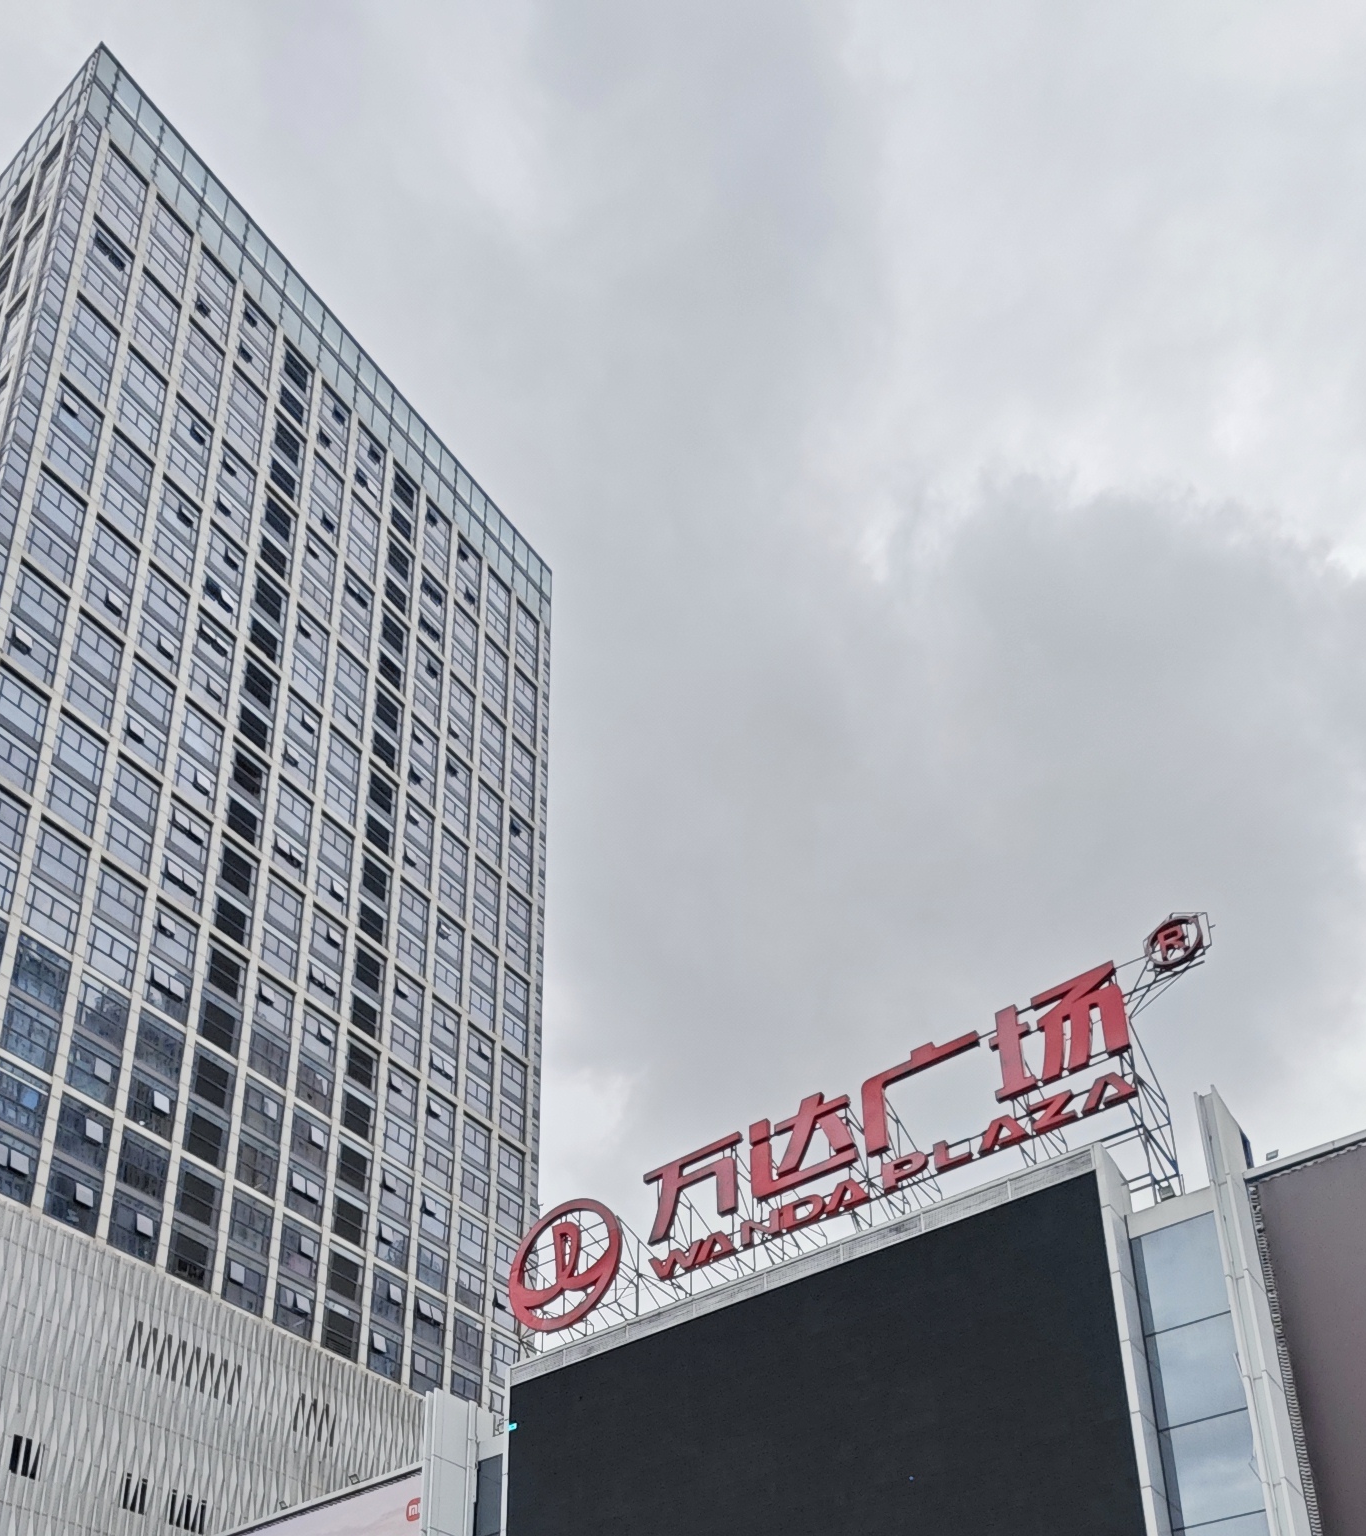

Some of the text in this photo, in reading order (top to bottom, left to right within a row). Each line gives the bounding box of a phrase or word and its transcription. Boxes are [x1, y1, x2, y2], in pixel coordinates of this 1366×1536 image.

[643, 961, 1131, 1244] 万达广场
[647, 1071, 1137, 1281] WANDA PLAZA
